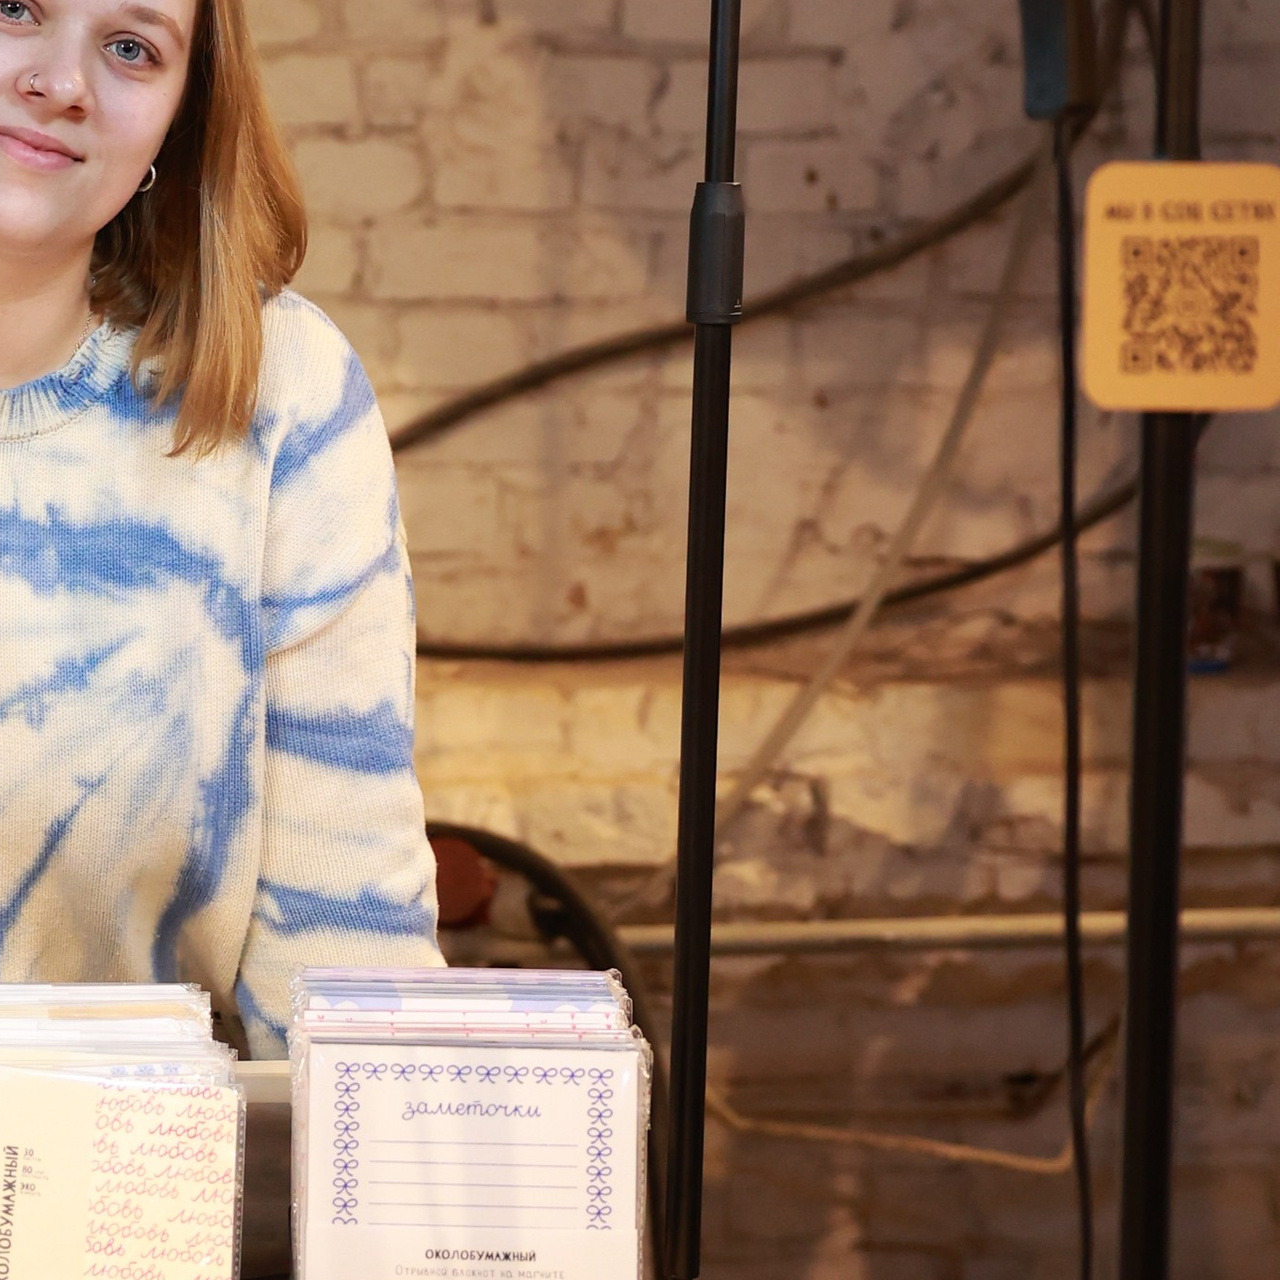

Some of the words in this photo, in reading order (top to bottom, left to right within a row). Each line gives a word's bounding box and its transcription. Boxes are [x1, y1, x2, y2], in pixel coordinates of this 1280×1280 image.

[401, 1099, 542, 1121] заметочки
[148, 1121, 234, 1144] любовь
[130, 1141, 218, 1164] любовь
[95, 1177, 179, 1200] любовь
[424, 1248, 537, 1263] ОКОЛОБУМАЖНЫЙ
